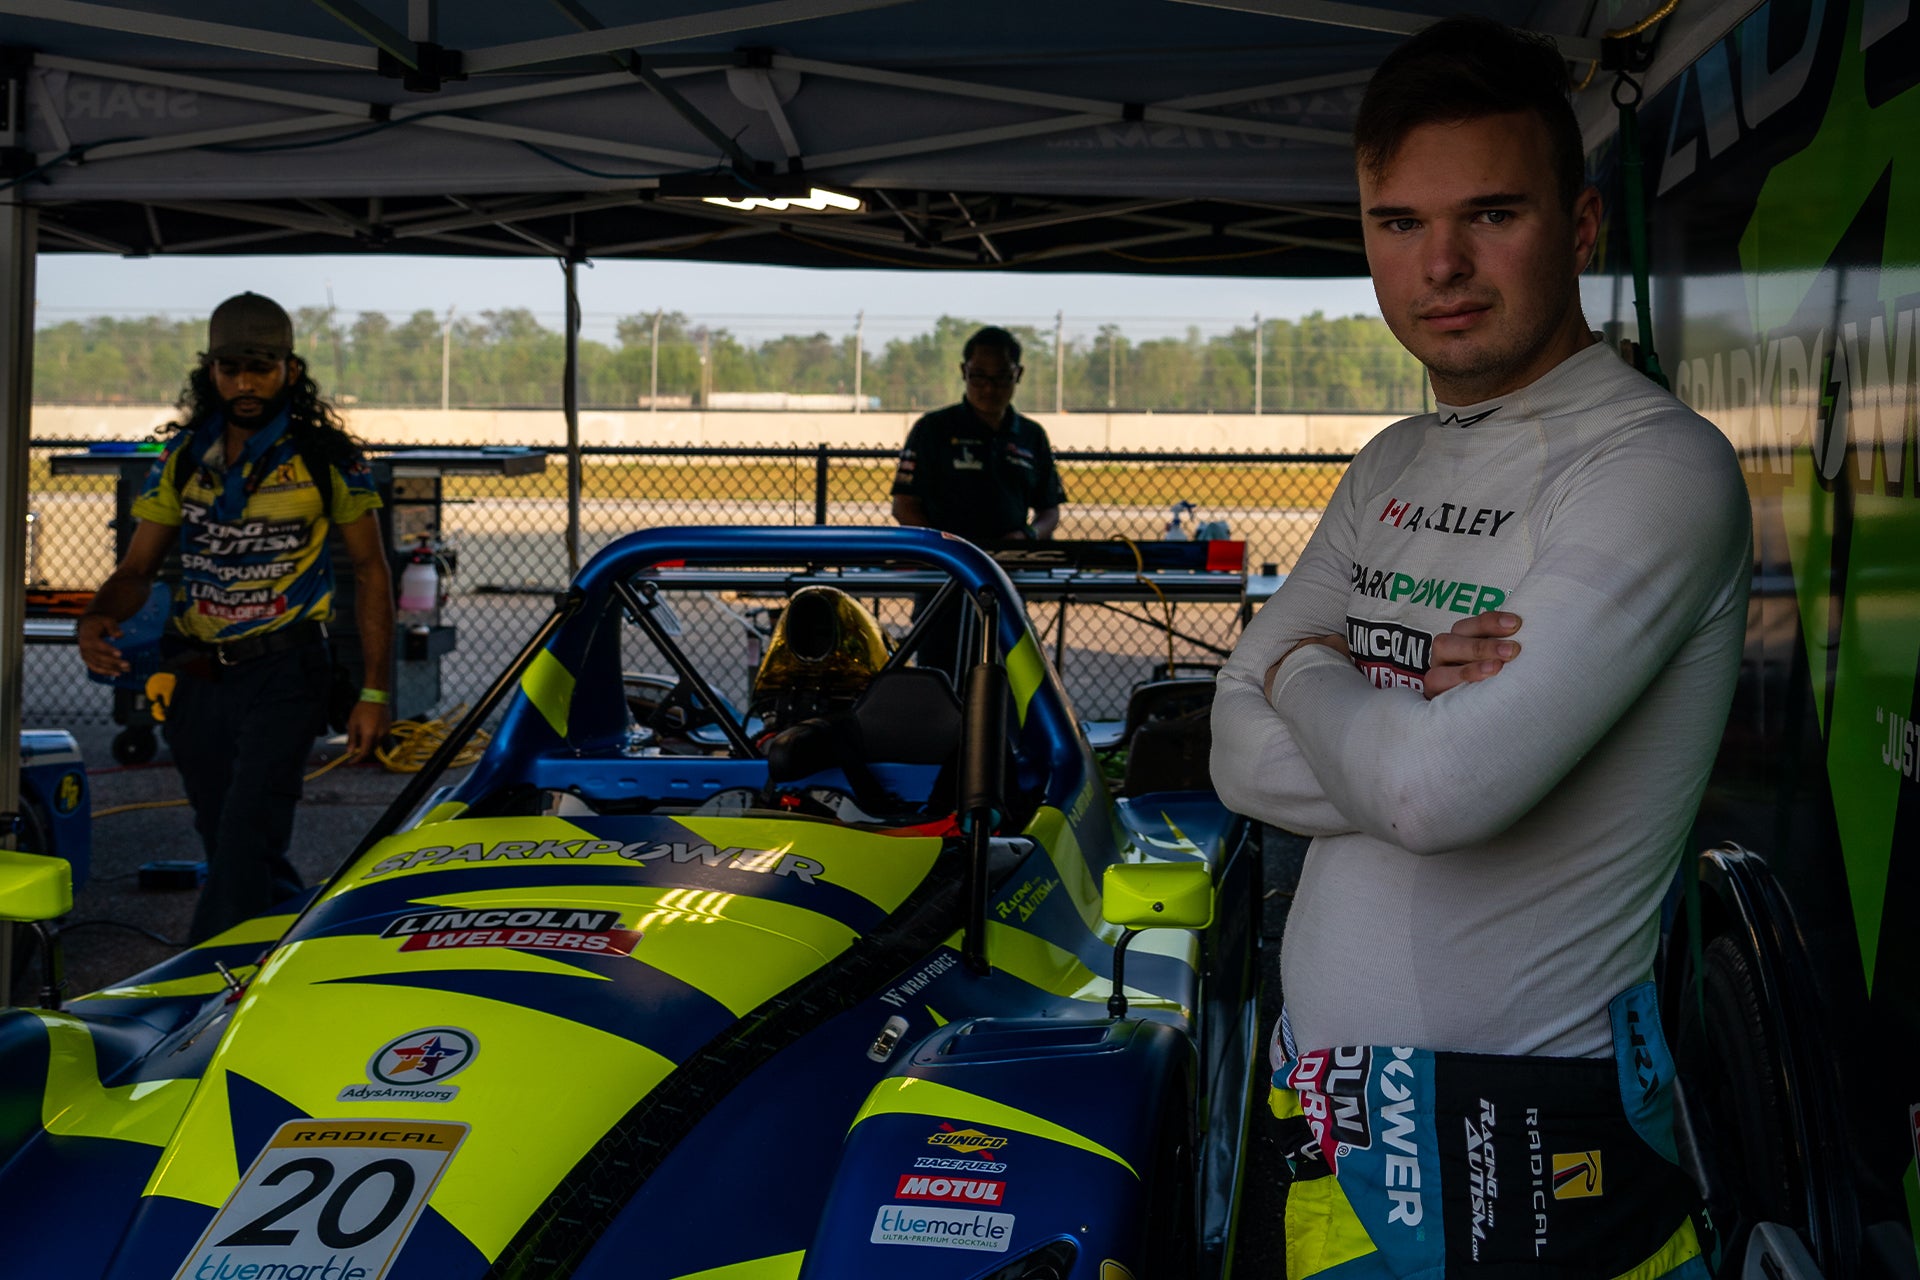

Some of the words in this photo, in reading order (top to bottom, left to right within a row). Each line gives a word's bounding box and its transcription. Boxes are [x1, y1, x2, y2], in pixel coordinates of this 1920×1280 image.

[362, 839, 825, 886] SPARKPOWER
[396, 910, 606, 936] LINCOLN
[426, 930, 611, 951] WELDERS
[899, 972, 931, 996] WRAP
[923, 952, 958, 979] FORCE
[342, 1084, 453, 1101] AdysArmy.org
[294, 1130, 444, 1145] RADICAL
[931, 1132, 1005, 1149] SUNOCO
[1479, 1097, 1499, 1199] RACING
[914, 1157, 958, 1170] RACE
[957, 1160, 1007, 1174] FUELS
[900, 1177, 999, 1201] MOTUL
[1525, 1107, 1548, 1258] RADICAL
[213, 1156, 416, 1250] 20
[881, 1209, 1005, 1239] bluemarble
[881, 1233, 949, 1244] ULTRA-PREMIUM
[951, 1238, 999, 1249] COCKTAILS
[195, 1252, 366, 1280] bluemarble
